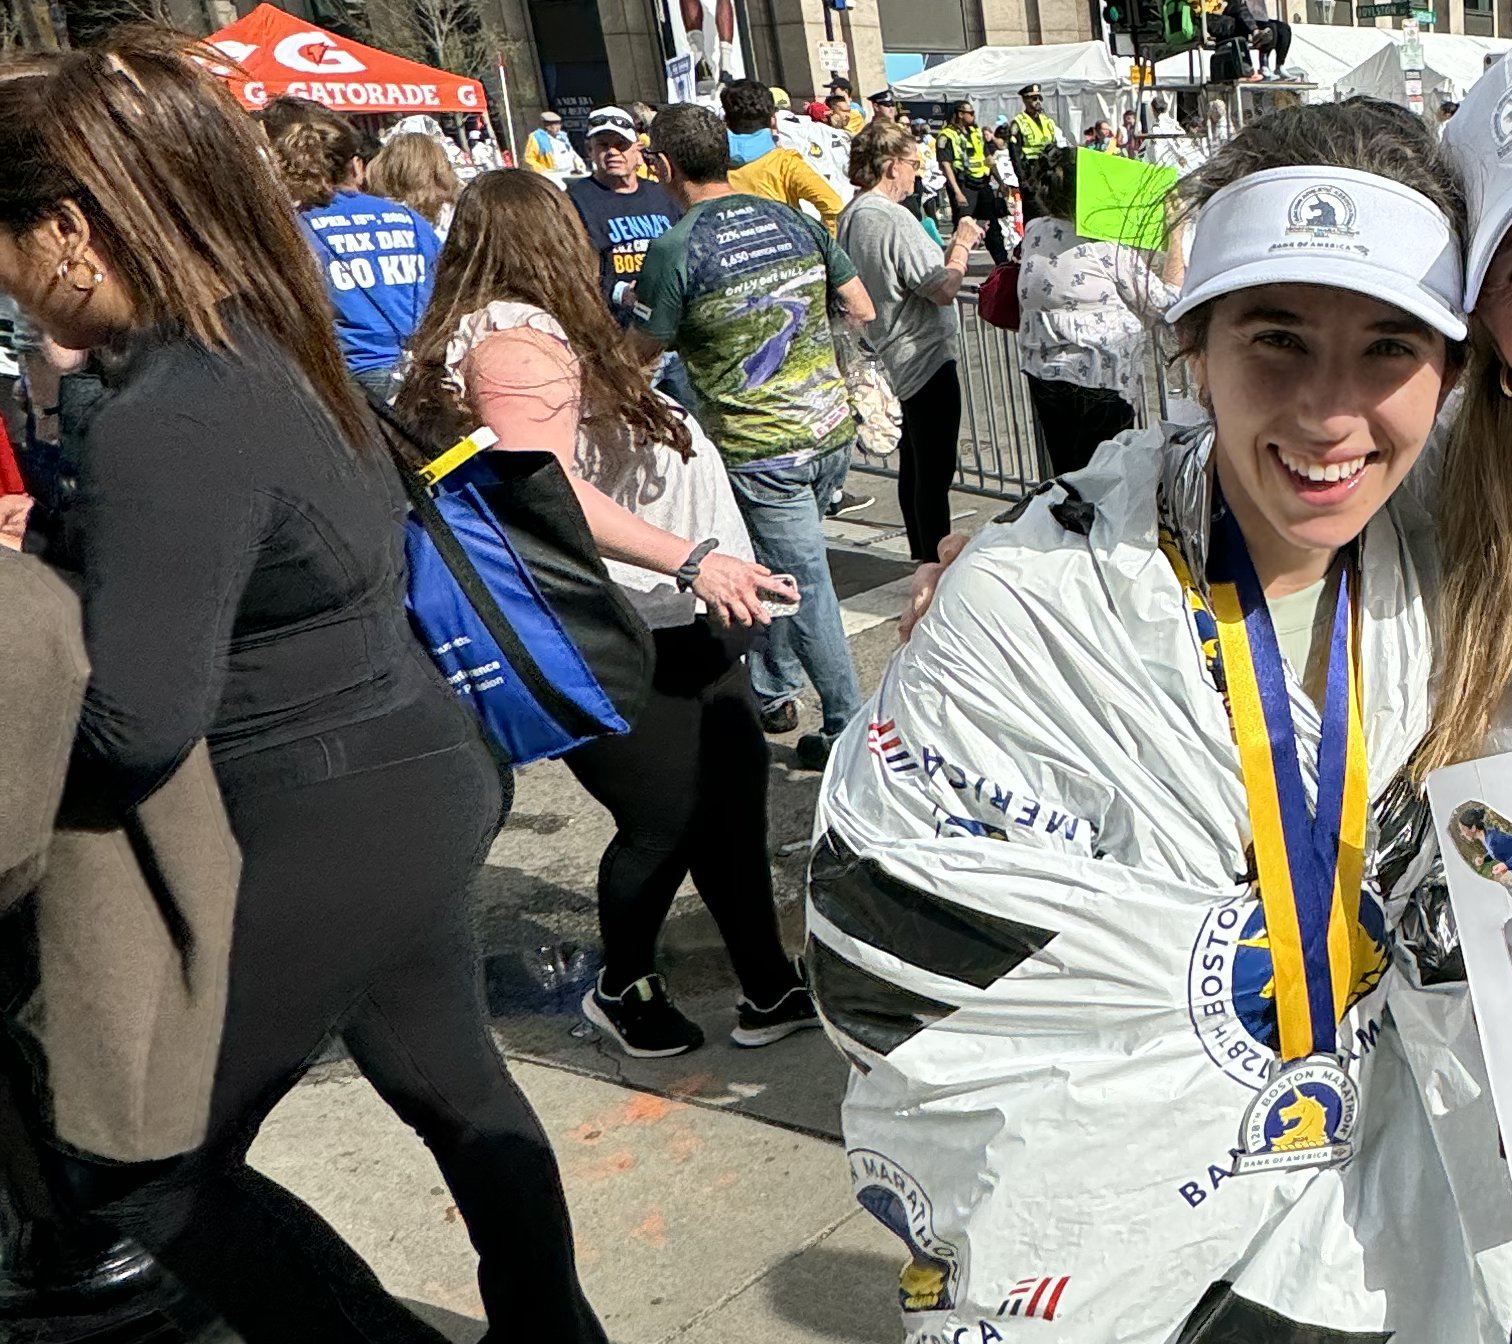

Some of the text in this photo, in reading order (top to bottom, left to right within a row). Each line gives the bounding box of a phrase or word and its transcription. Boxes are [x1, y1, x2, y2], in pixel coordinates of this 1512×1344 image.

[273, 31, 368, 74] G
[287, 82, 440, 105] GATORADE
[457, 85, 478, 106] G
[310, 215, 351, 231] APRIL
[327, 230, 416, 254] TAX DAY
[716, 229, 741, 245] 22%
[1311, 242, 1351, 251] AMERICA
[720, 251, 749, 268] 4,650
[330, 257, 376, 291] GO
[725, 278, 758, 297] ONLY
[1261, 1070, 1314, 1108] BOSTON
[1321, 1070, 1355, 1134] MARATHON
[1243, 1158, 1270, 1168] BANK
[1286, 1151, 1328, 1162] AMERICA
[861, 1156, 959, 1283] MARATHON
